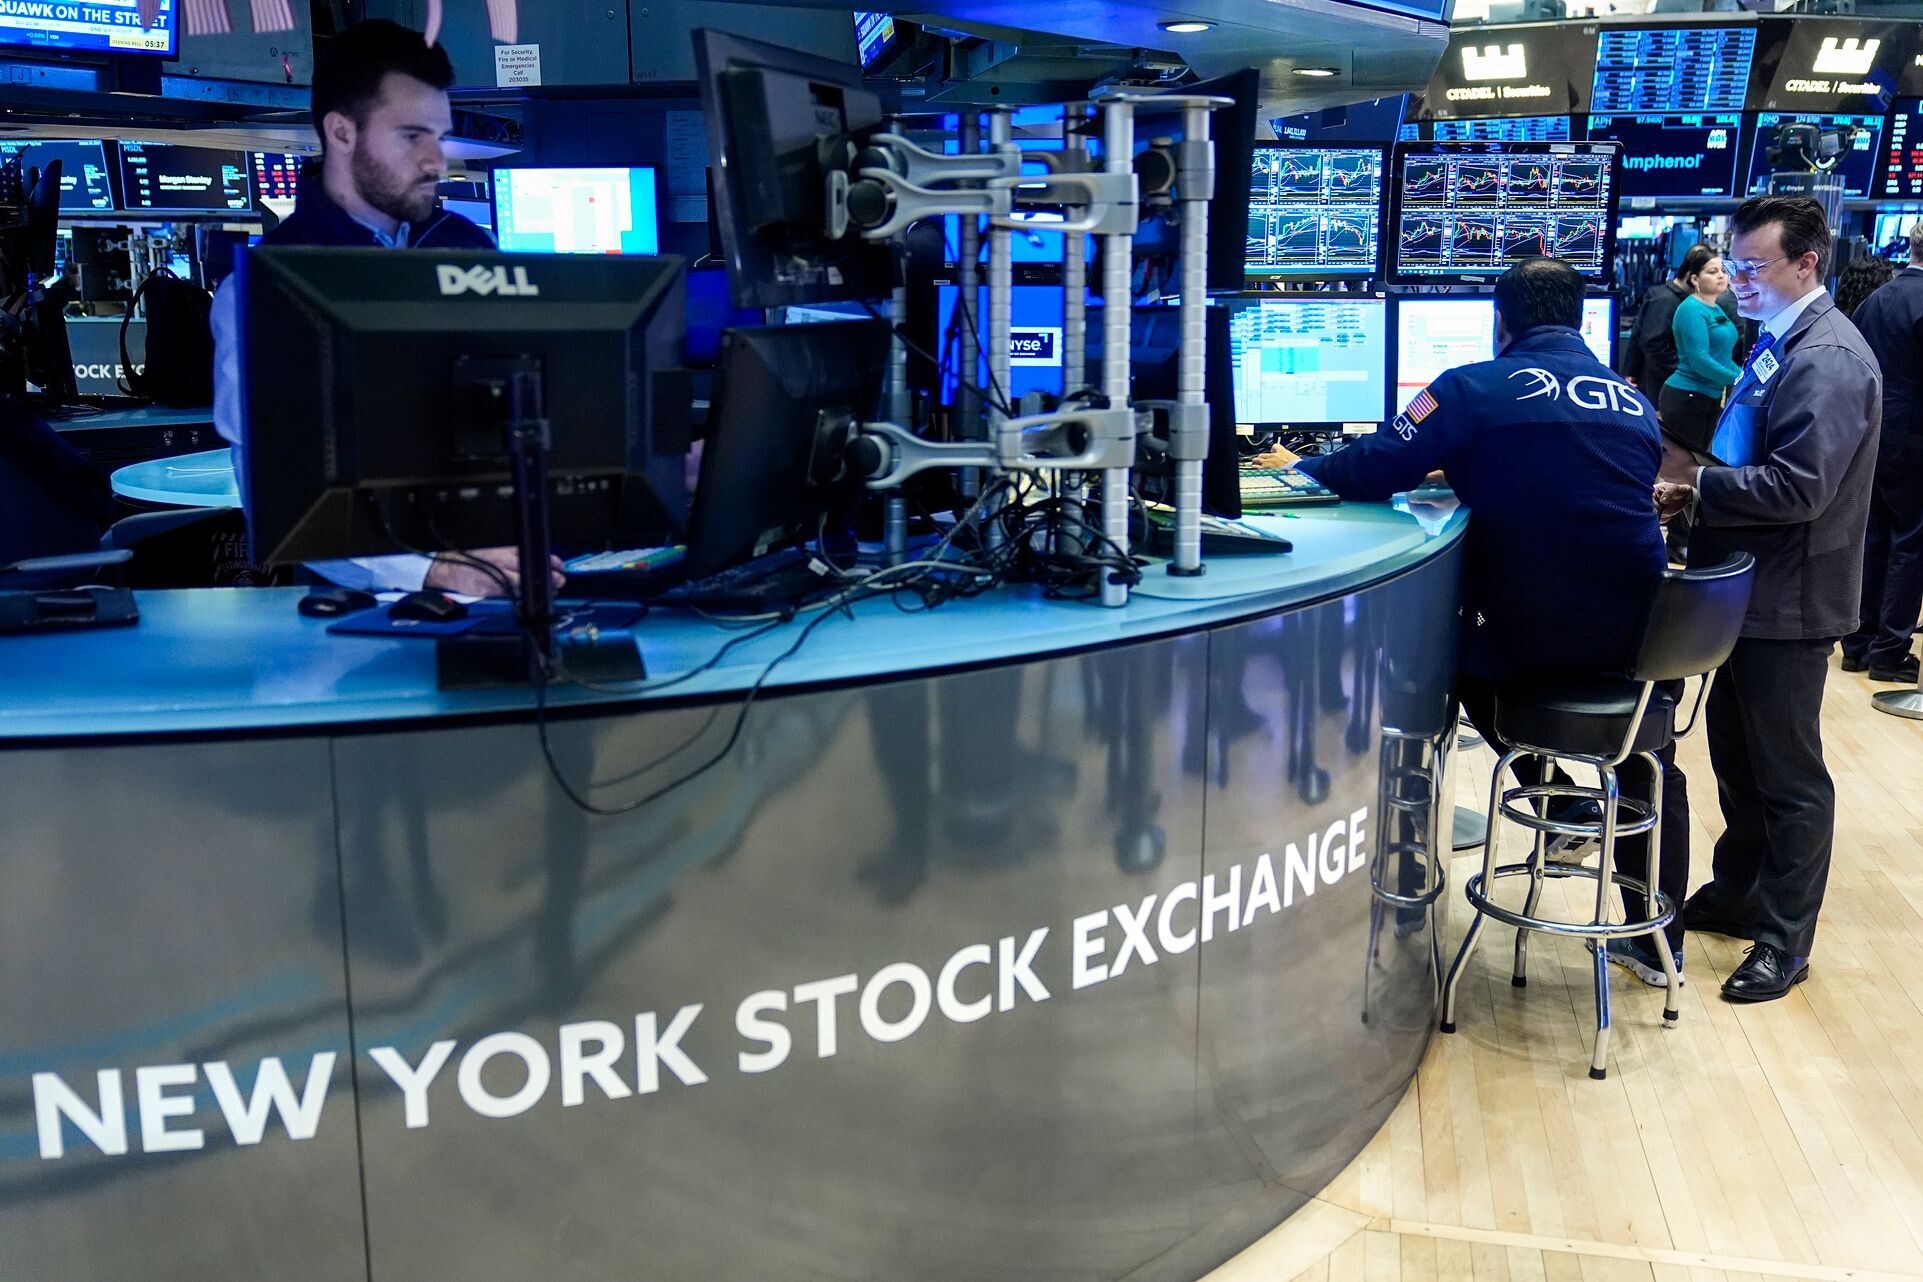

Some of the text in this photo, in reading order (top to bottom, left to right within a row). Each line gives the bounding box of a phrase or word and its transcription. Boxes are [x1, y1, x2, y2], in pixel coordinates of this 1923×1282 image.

[56, 6, 78, 20] ON
[83, 8, 110, 23] THE
[115, 11, 167, 28] STRT
[145, 40, 165, 48] 05:37
[1446, 87, 1495, 100] CITADEL
[1786, 80, 1830, 92] CITADEL
[1594, 117, 1612, 126] APH
[123, 144, 144, 152] MSDL
[436, 264, 539, 295] DELL
[72, 364, 112, 379] OCK
[1567, 375, 1644, 417] GTS
[1392, 414, 1418, 441] GTS
[31, 805, 1369, 1159] NEW YORK STOCK EXCHANGE
